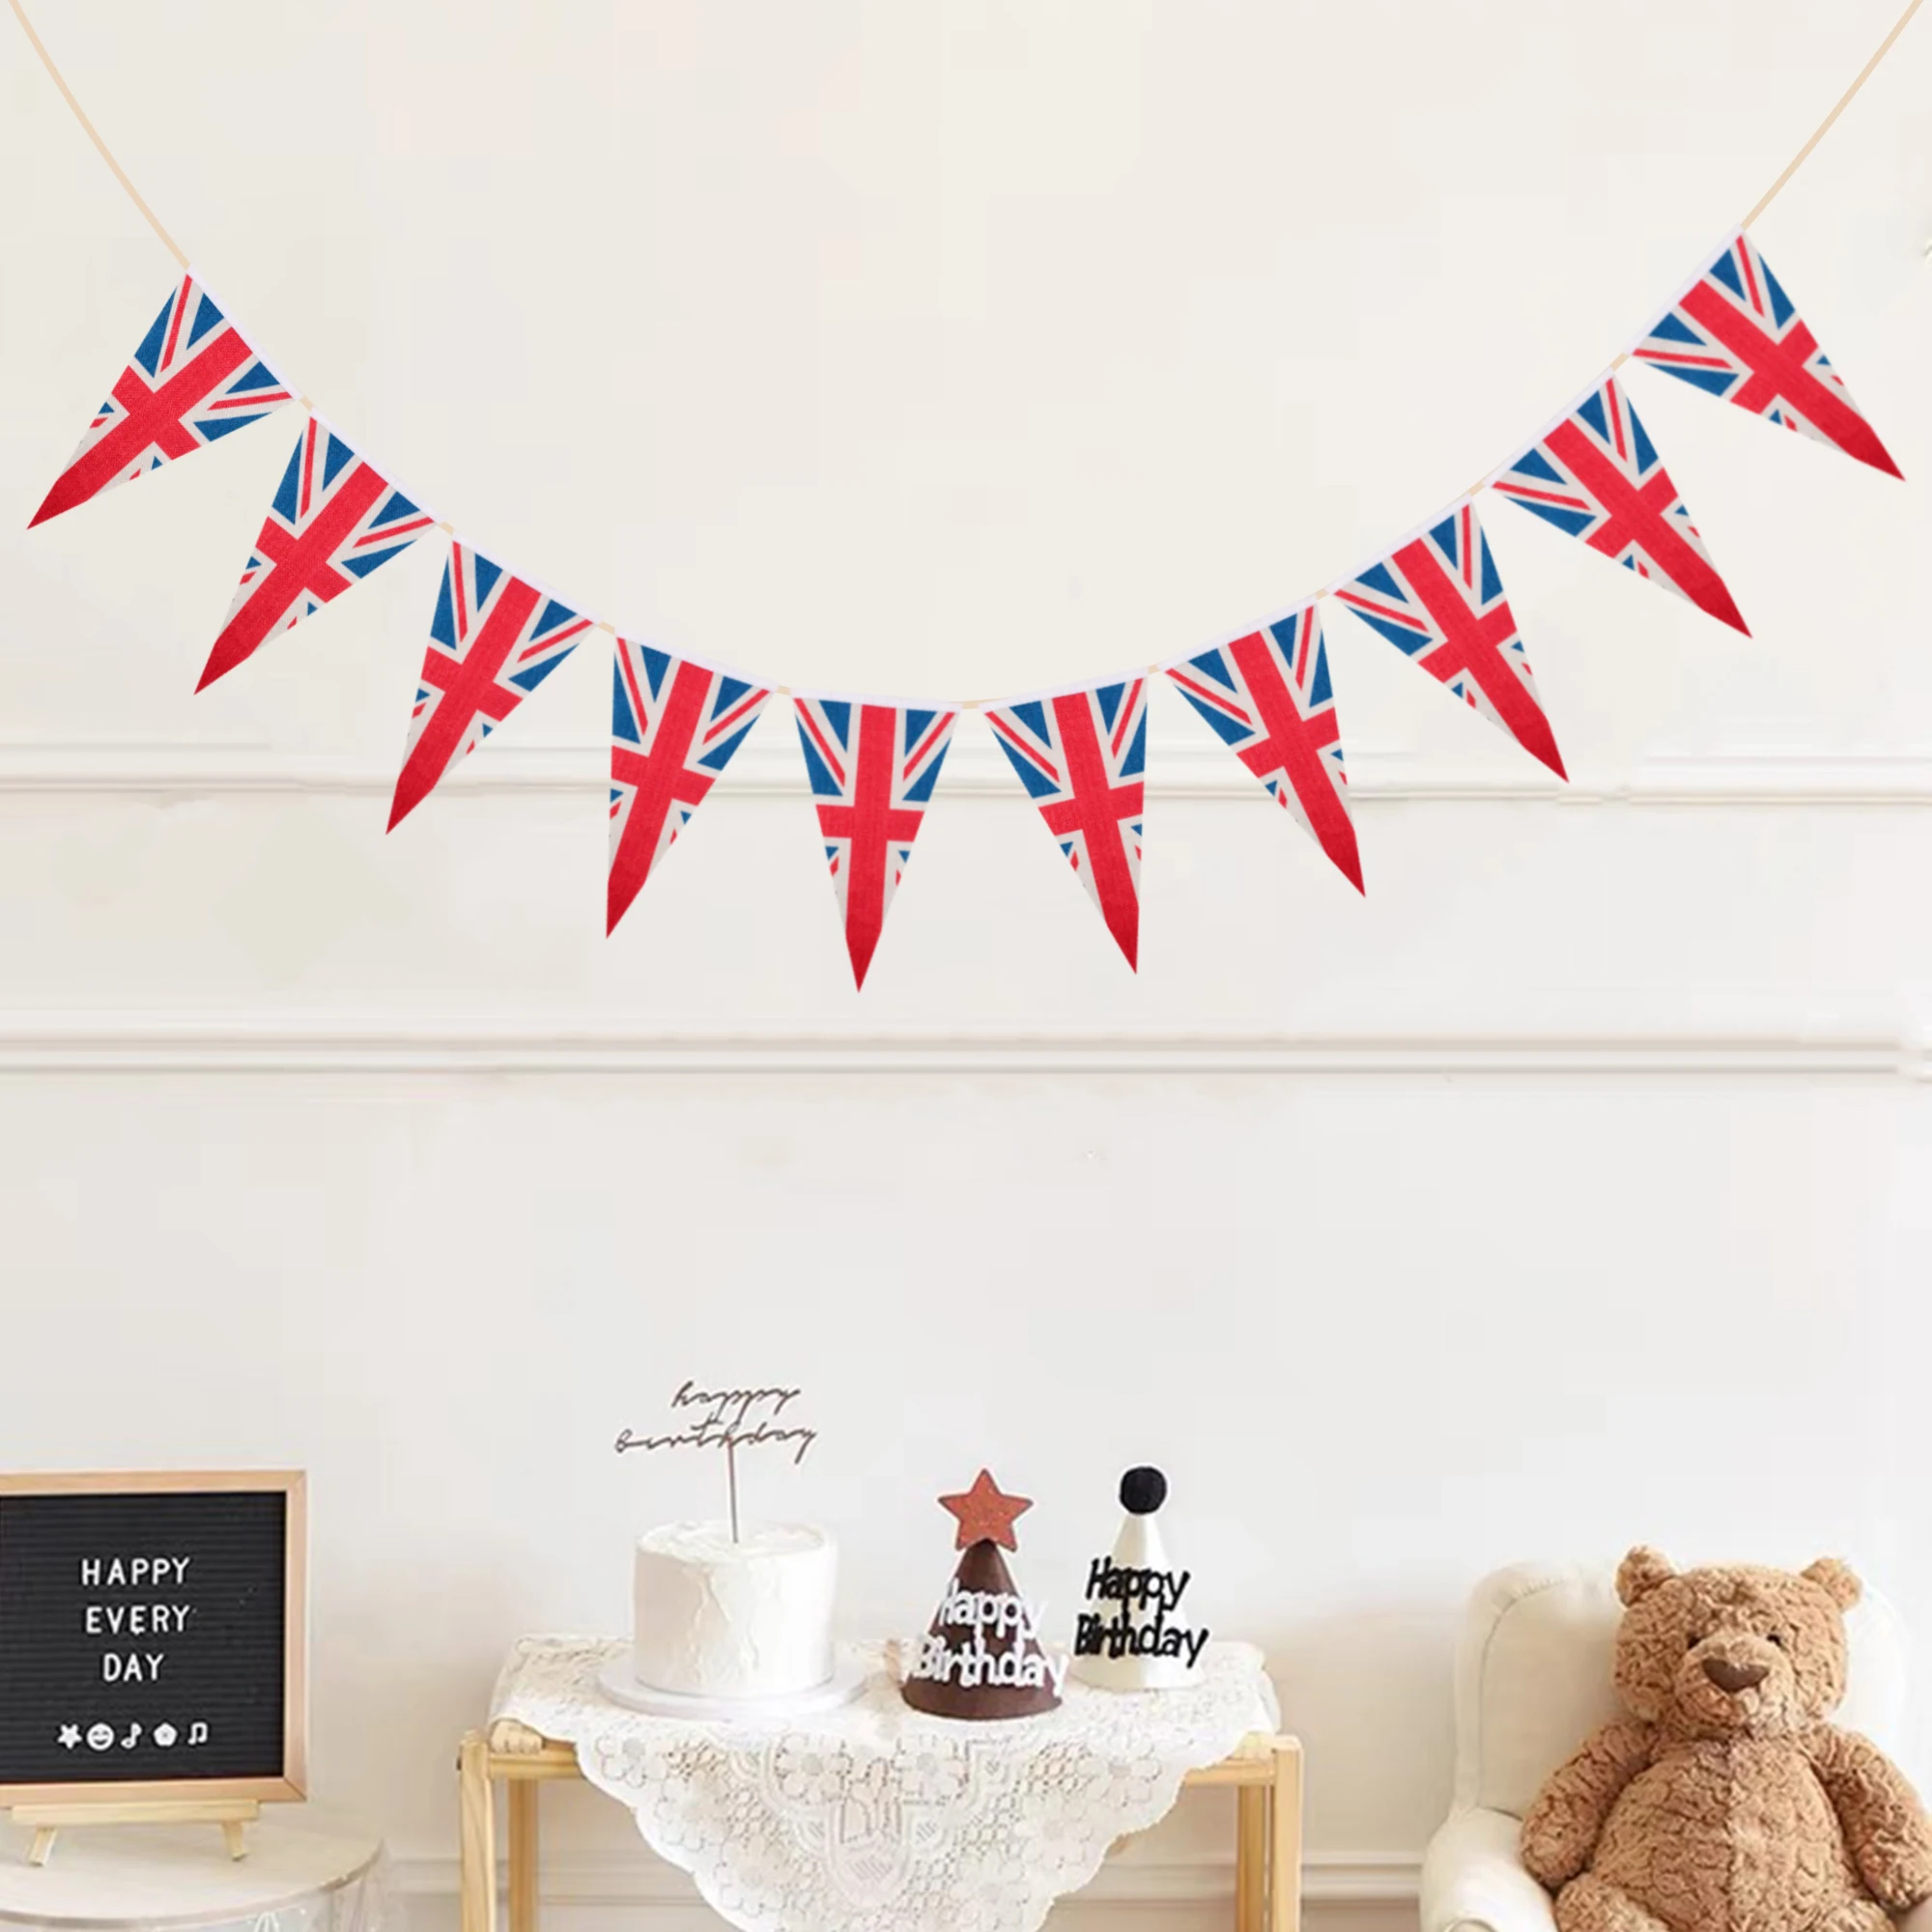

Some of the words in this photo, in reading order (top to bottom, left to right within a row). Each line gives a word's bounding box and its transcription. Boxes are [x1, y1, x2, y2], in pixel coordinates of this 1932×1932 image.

[671, 1380, 801, 1424] happy
[81, 1557, 190, 1586] HAPPY
[1085, 1556, 1191, 1611] Happy
[85, 1605, 190, 1634] EVERY
[938, 1577, 1049, 1639] Happy
[1074, 1612, 1209, 1668] Birthday
[103, 1653, 164, 1682] DAY
[912, 1634, 1069, 1697] Birthday
